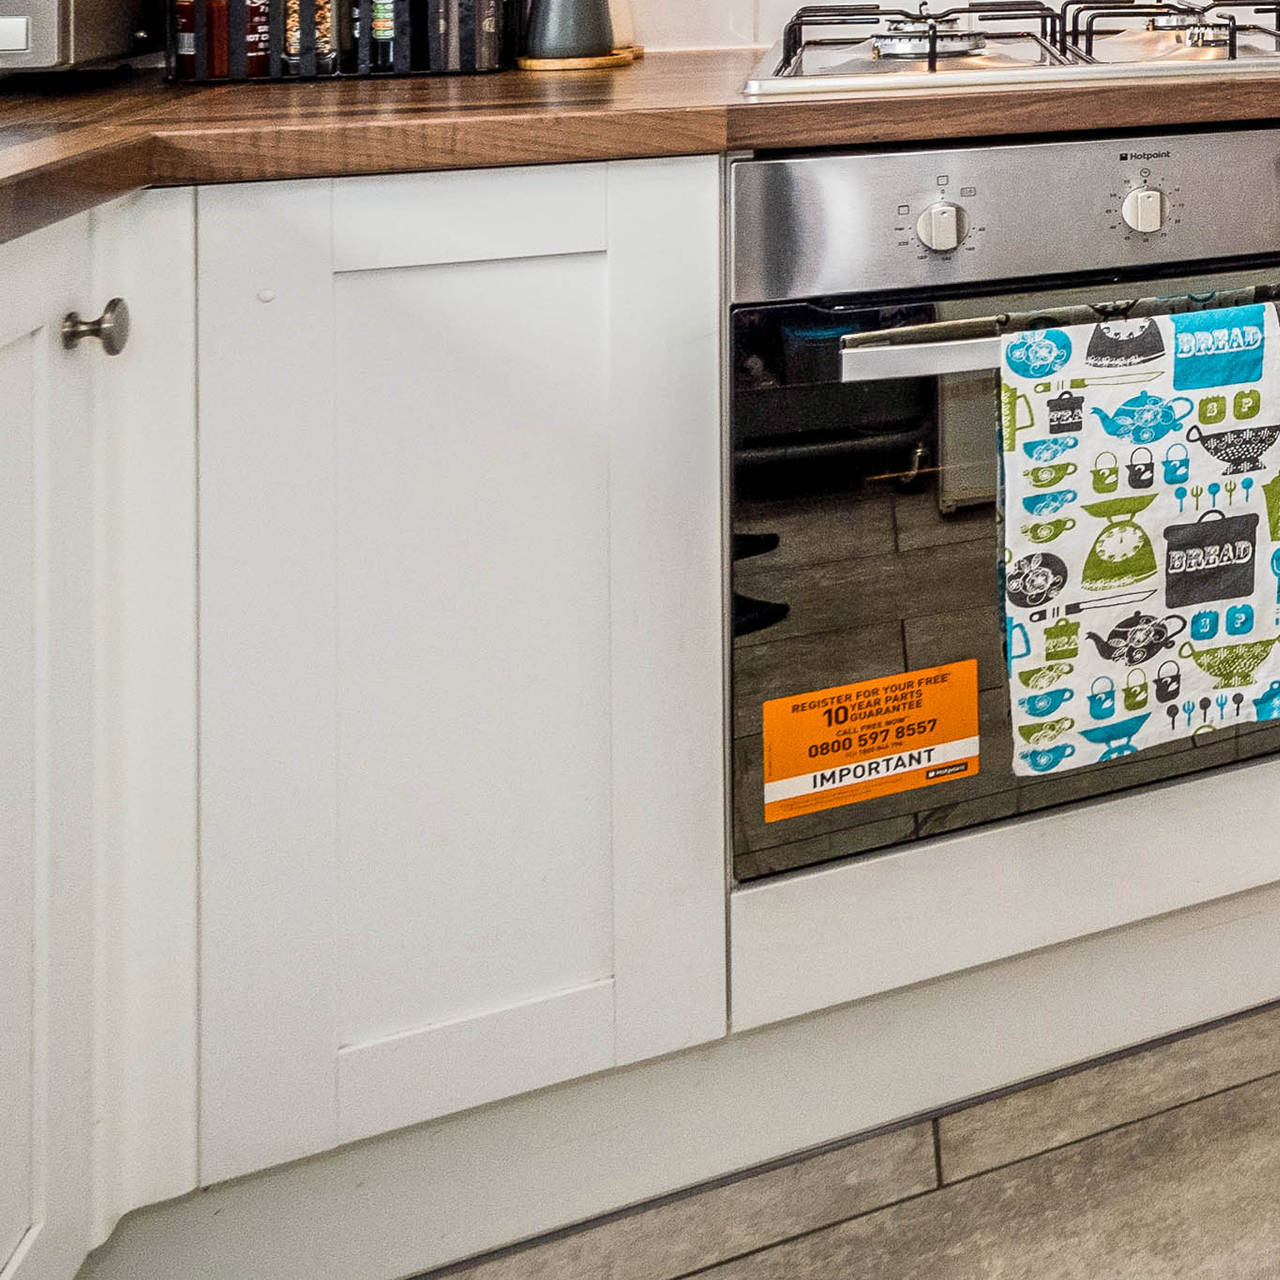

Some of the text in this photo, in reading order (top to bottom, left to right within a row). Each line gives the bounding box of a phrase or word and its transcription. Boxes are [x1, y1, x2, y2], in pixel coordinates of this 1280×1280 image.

[1130, 150, 1171, 161] Hotpoint
[1175, 325, 1264, 359] BREAD
[1240, 397, 1253, 413] P
[1167, 539, 1255, 577] BREAD
[791, 692, 853, 714] REGISTER
[856, 687, 880, 701] FOR
[882, 681, 916, 697] YOUR
[822, 688, 924, 728] 10 YEAR PARTS
[850, 698, 923, 723] GUARANTEE
[808, 736, 853, 759] 0800
[857, 728, 890, 748] 597
[894, 718, 938, 740] 8557
[811, 747, 936, 790] IMPORTANT
